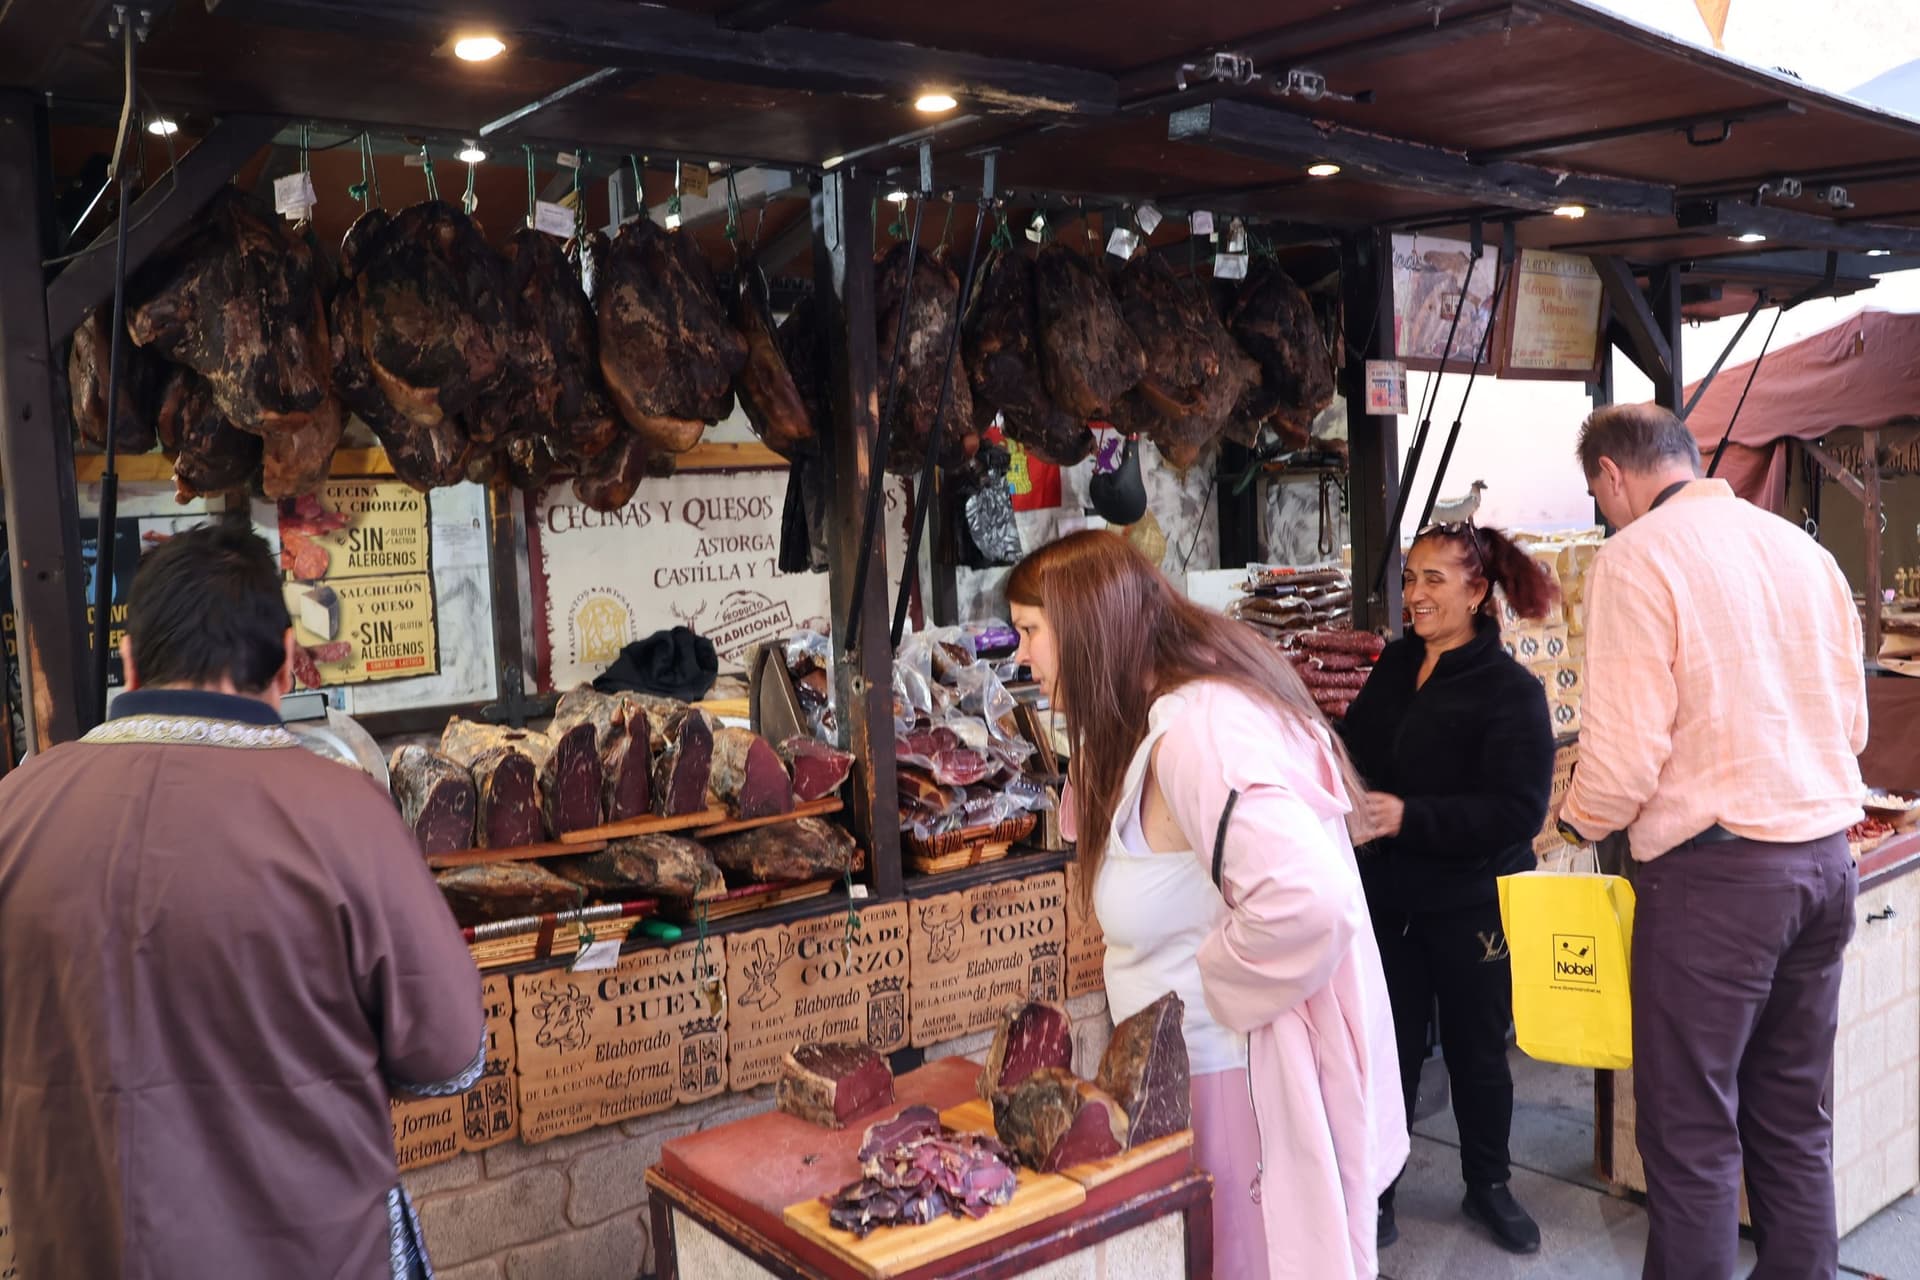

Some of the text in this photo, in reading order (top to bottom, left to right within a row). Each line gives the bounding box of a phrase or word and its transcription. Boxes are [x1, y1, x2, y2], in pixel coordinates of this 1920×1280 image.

[327, 487, 379, 498] CECINA
[334, 500, 418, 513] Y CHORIZO
[659, 500, 673, 523] Y
[682, 496, 774, 530] QUESOS
[349, 527, 384, 552] SIN
[694, 534, 775, 559] ASTORGA
[348, 551, 417, 568] ALERGENOS
[747, 561, 757, 578] Y
[340, 580, 422, 599] SALCHICHÓN
[357, 600, 414, 615] Y QUESO
[722, 600, 764, 622] PRODUCTO
[360, 620, 394, 646] SIN
[712, 610, 788, 649] RADICIONAL
[361, 641, 425, 660] ALERGENOS
[1027, 878, 1057, 891] CECINA
[811, 922, 829, 933] REY
[863, 909, 898, 923] CECINA
[970, 894, 1062, 925] CECINA DE
[879, 926, 904, 943] DE
[980, 916, 1054, 947] TORO
[639, 955, 653, 967] DE
[655, 952, 670, 963] LA
[966, 950, 1023, 979] Elaborado
[1557, 961, 1593, 977] Nobel
[597, 969, 686, 1001] CECINA
[973, 979, 1022, 1002] de forma
[616, 990, 703, 1028] BUEY
[794, 987, 860, 1018] Elaborado
[802, 1017, 859, 1043] de forma
[922, 1013, 956, 1029] Astorga
[595, 1029, 671, 1064] Elaborado
[546, 1061, 585, 1080] EL REY
[605, 1060, 670, 1090] de forma
[743, 1055, 782, 1071] Astorga
[526, 1076, 604, 1102] DE LA CECINA
[537, 1103, 585, 1123] Astorga
[599, 1084, 674, 1119] tradicional
[402, 1107, 453, 1140] forma
